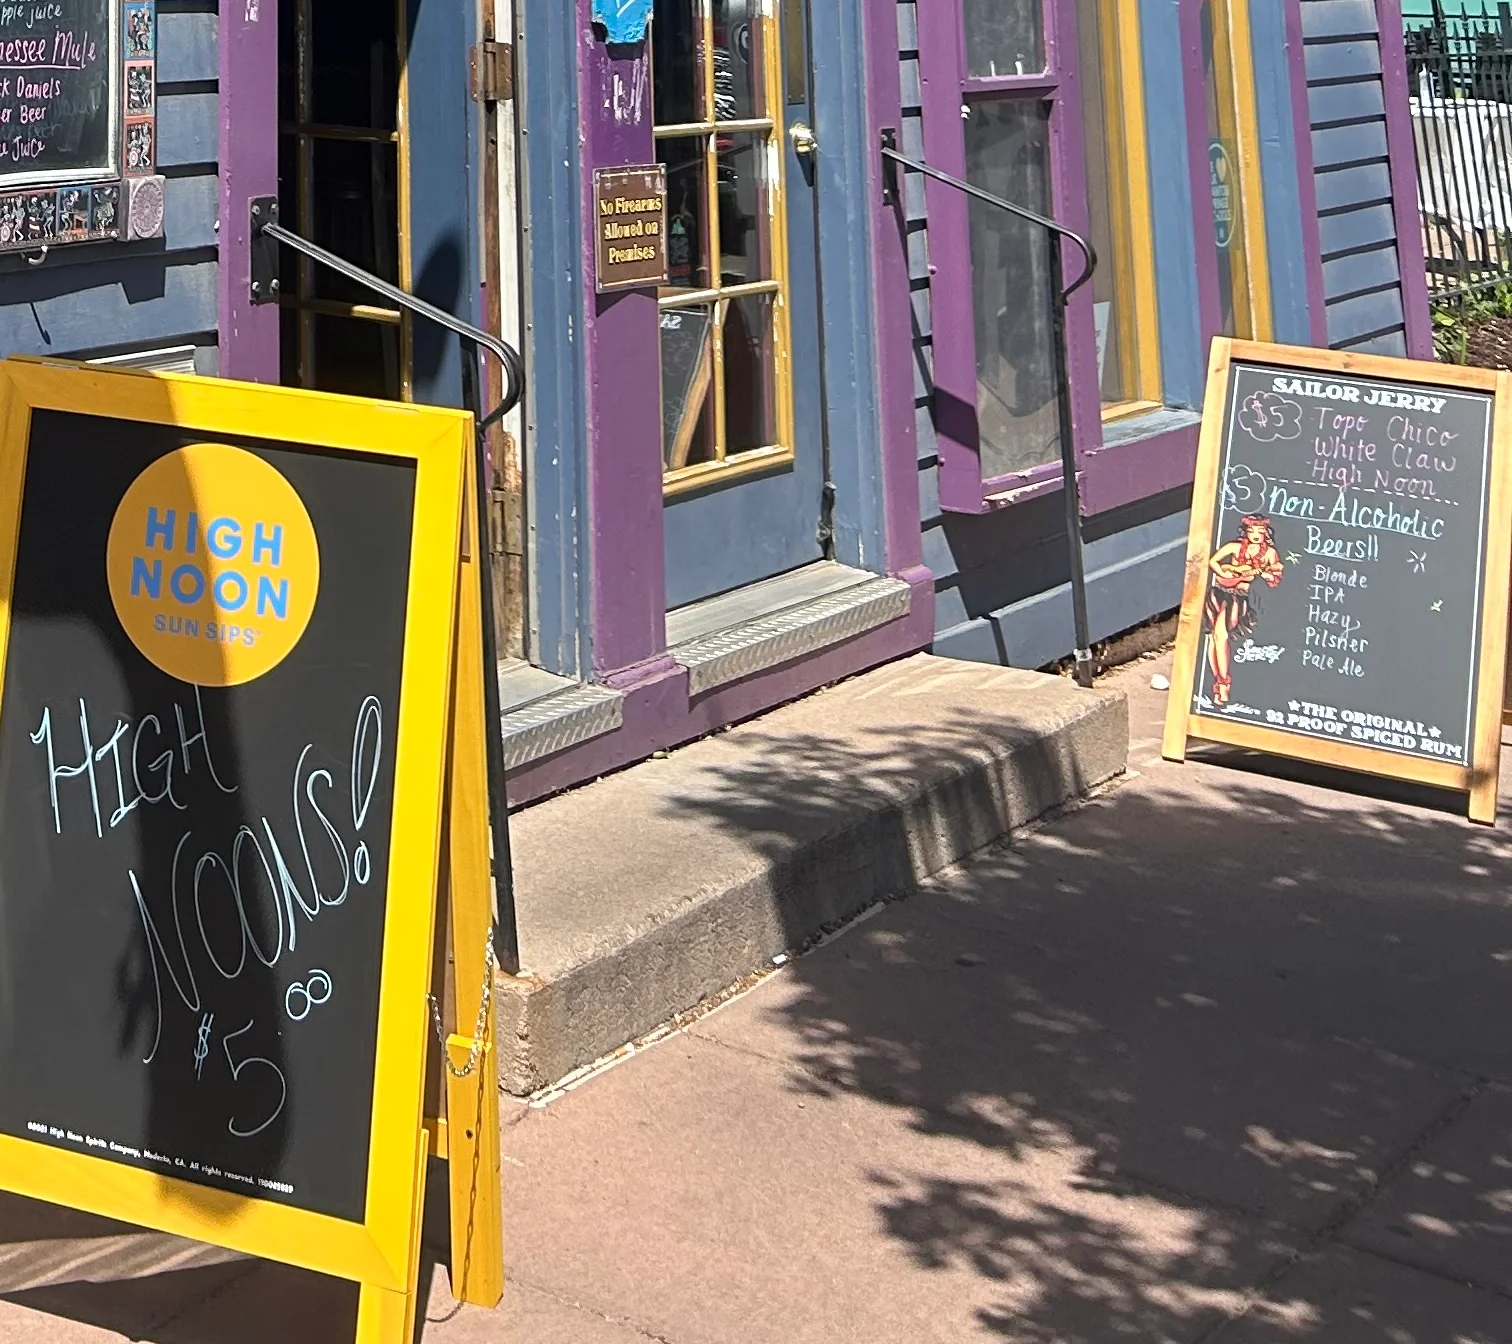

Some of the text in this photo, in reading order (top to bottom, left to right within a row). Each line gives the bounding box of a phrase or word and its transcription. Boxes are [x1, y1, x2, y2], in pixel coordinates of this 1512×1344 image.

[52, 30, 96, 68] Mule
[16, 75, 61, 99] Daniels
[20, 104, 46, 124] Beer
[12, 136, 45, 161] Juice
[600, 194, 662, 216] No Firearms
[604, 219, 658, 240] Allowed on
[608, 244, 655, 264] Premises
[1272, 377, 1447, 414] SAILOR JERRY
[1251, 400, 1460, 447] $5 Topo Chico
[1315, 437, 1457, 472] White Claw
[1311, 461, 1437, 497] High Noon
[145, 506, 283, 567] HIGH
[130, 556, 289, 620] NOON
[1313, 564, 1368, 589] Blonde
[1309, 585, 1346, 604] IPA
[154, 614, 199, 637] SUN
[1308, 604, 1360, 638] Hazy
[1305, 627, 1369, 653] Pilsner
[1302, 650, 1364, 677] Pale Ale
[1287, 714, 1348, 736] PROOF
[1351, 728, 1416, 750] SPICED
[1419, 739, 1462, 758] RUM
[1300, 701, 1429, 737] THE ORIGINAL
[30, 681, 239, 838] HIGH
[49, 1126, 64, 1139] High
[189, 1161, 199, 1170] All
[201, 1166, 221, 1175] rights
